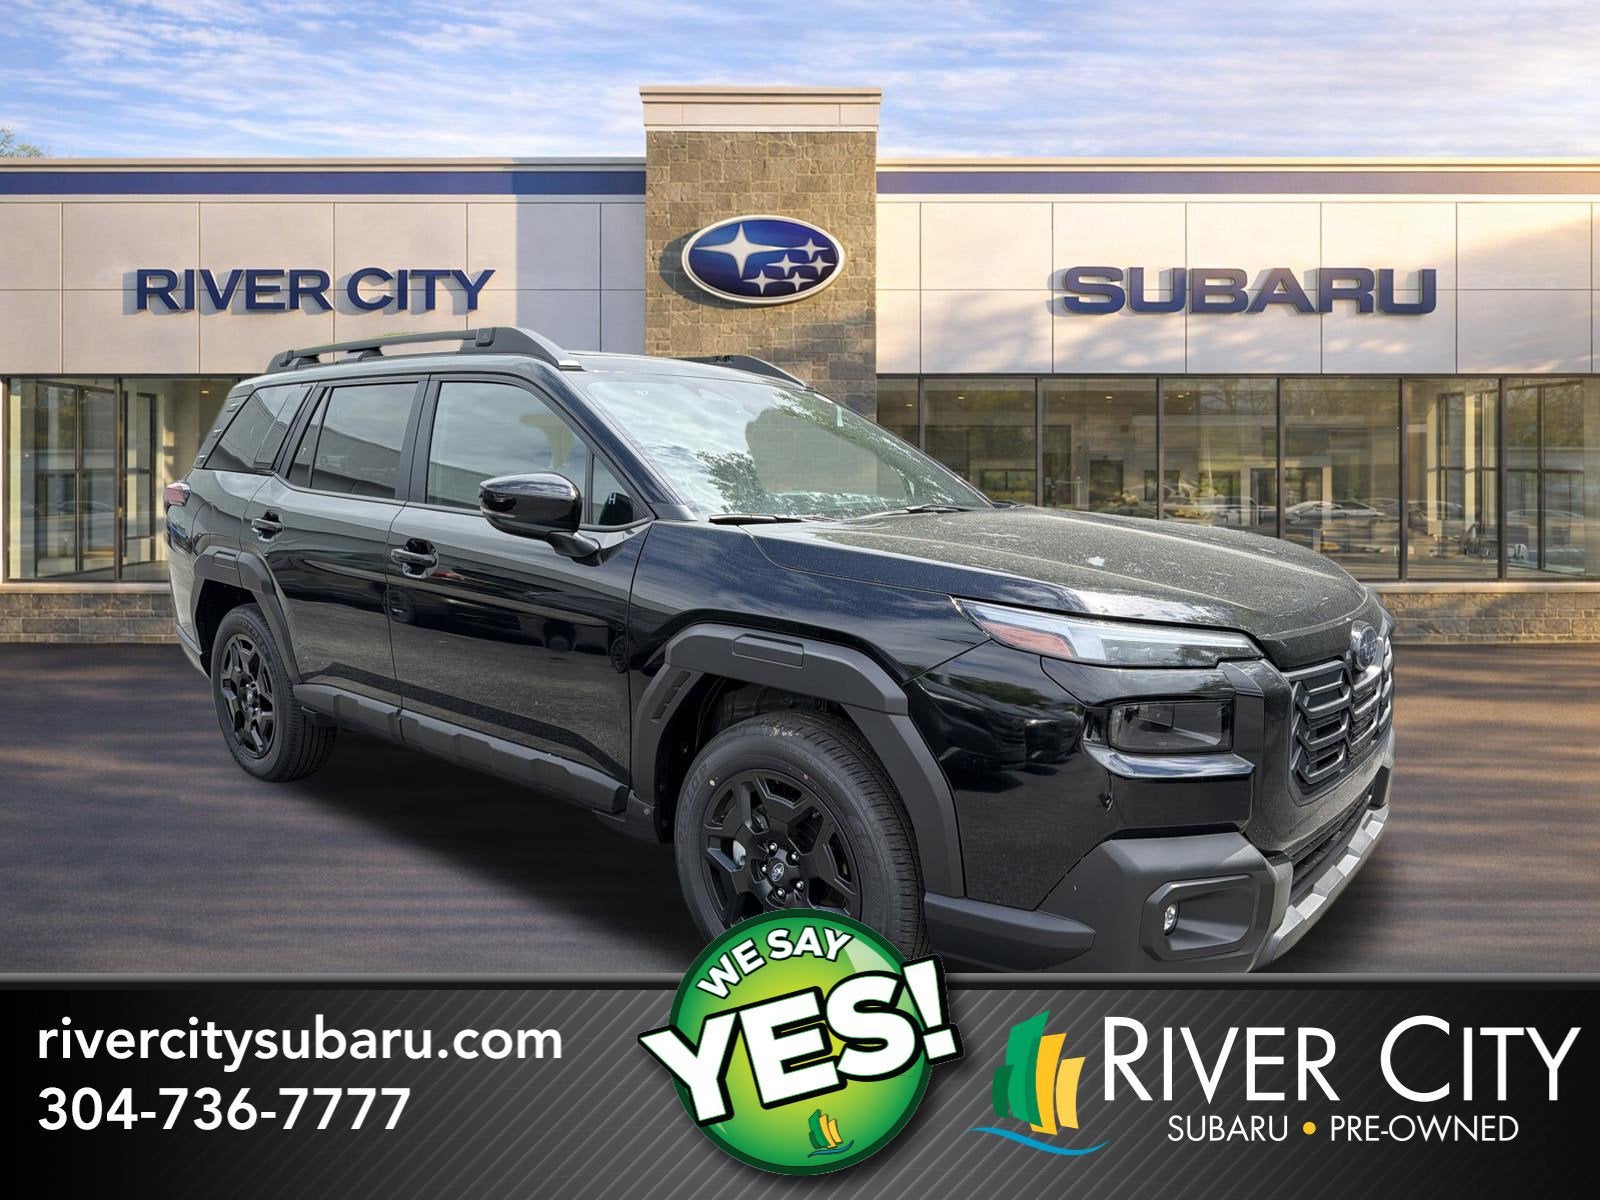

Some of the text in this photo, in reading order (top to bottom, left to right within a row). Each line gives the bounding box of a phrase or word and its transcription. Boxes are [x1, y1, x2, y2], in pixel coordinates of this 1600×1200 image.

[136, 267, 496, 311] RIVER CITY
[1063, 266, 1437, 315] SUBARU
